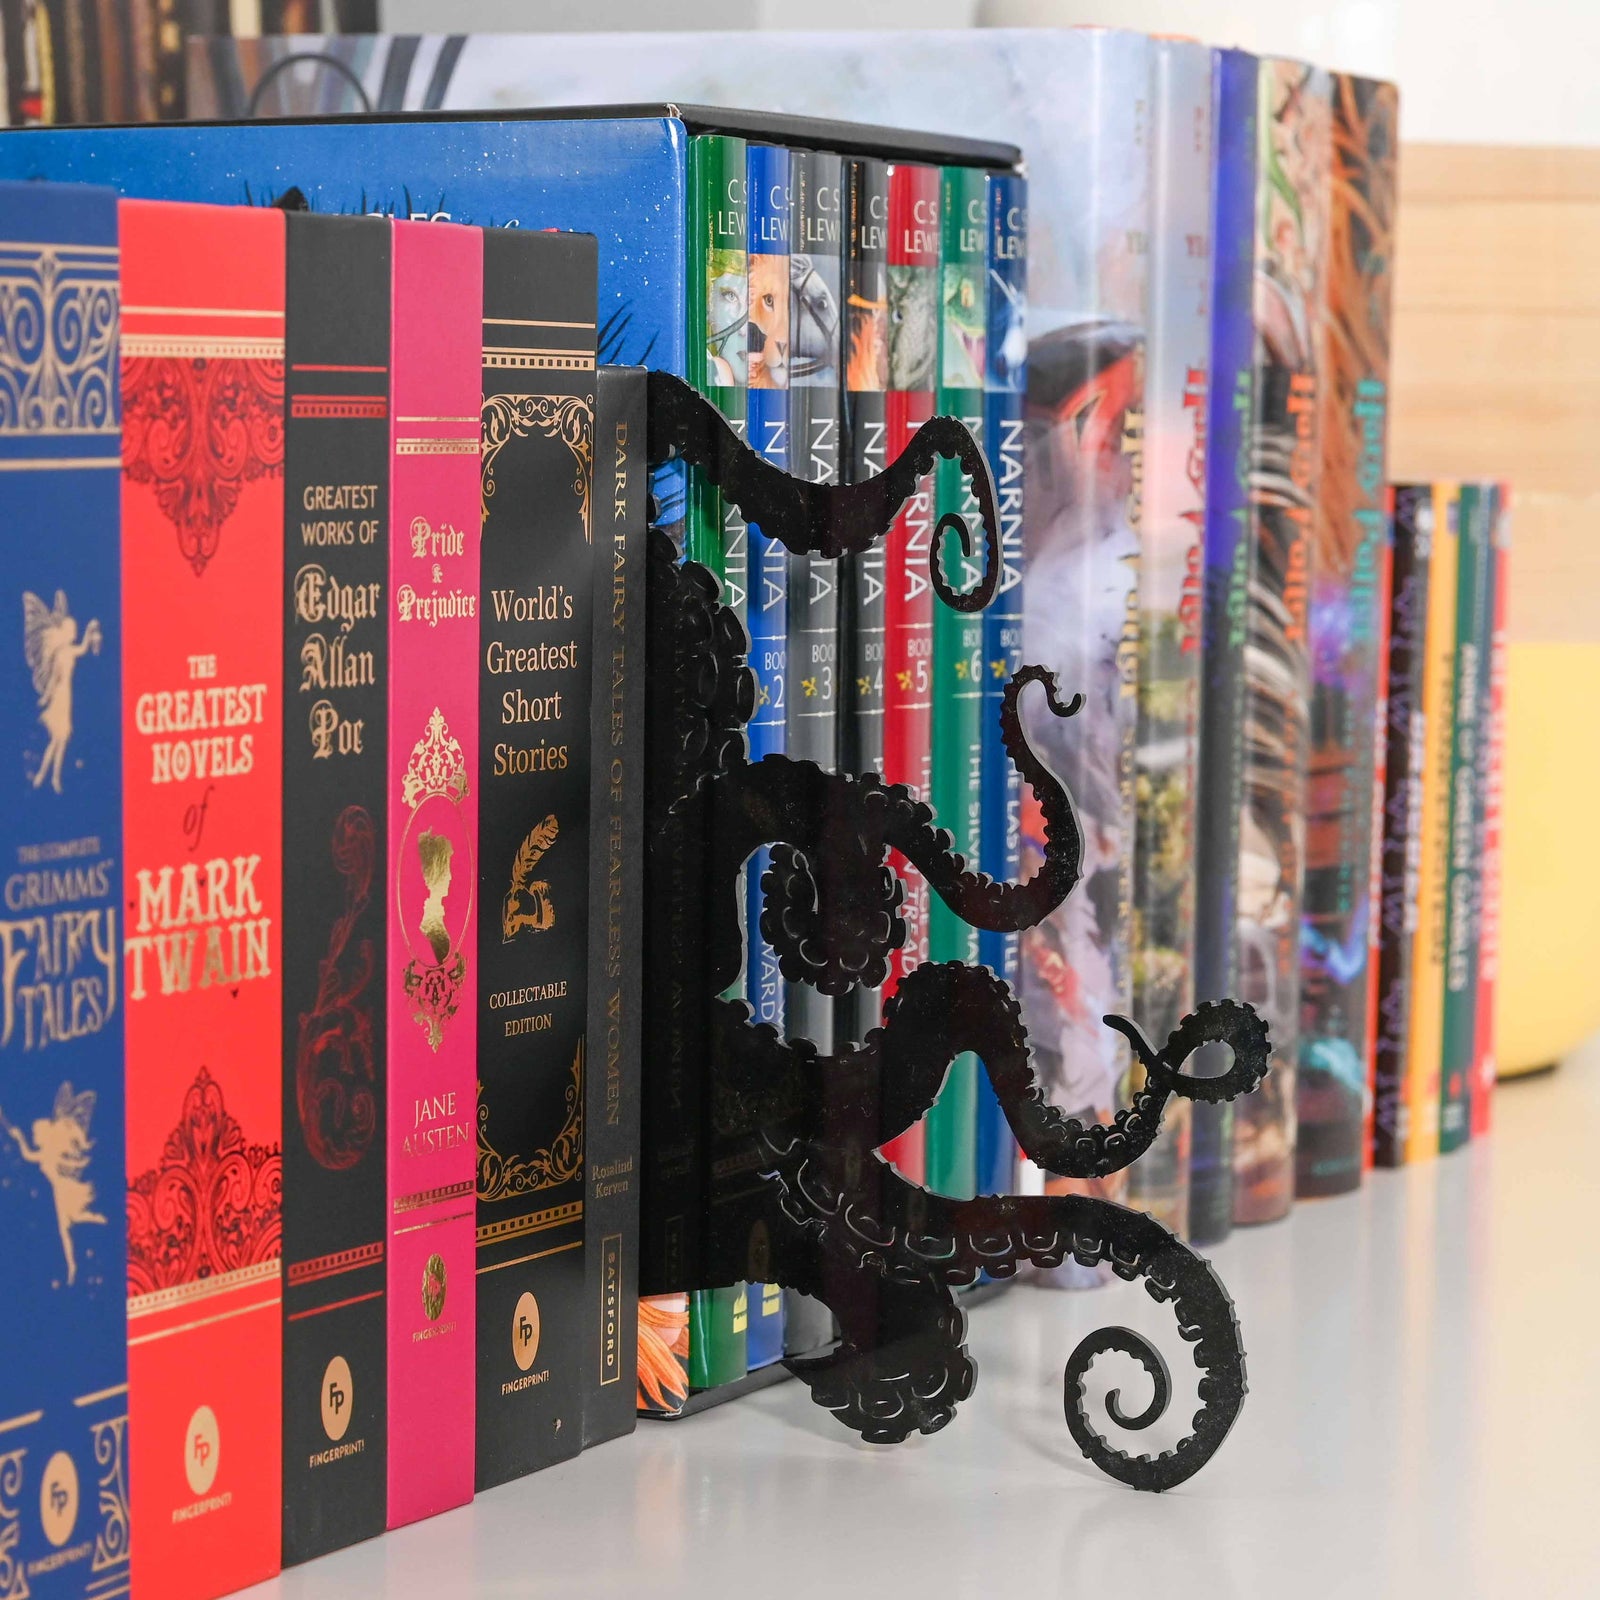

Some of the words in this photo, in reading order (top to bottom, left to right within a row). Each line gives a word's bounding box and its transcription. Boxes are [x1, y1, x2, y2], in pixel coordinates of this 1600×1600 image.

[613, 420, 629, 522] DARK
[303, 485, 378, 511] GREATEST
[1000, 420, 1024, 593] NARNIA
[301, 520, 354, 547] WORKS
[359, 520, 379, 545] OF
[409, 515, 466, 559] Pride
[293, 562, 381, 633] Edgar
[491, 585, 574, 622] World's
[612, 533, 628, 635] FAIRY
[396, 583, 477, 628] Prejudice
[187, 654, 217, 679] THE
[299, 632, 376, 693] Allan
[486, 640, 579, 675] Greatest
[916, 659, 928, 693] 5
[970, 648, 983, 683] 6
[610, 644, 626, 747] TALES
[773, 674, 785, 708] 2
[822, 665, 832, 700] 3
[873, 665, 884, 697] 4
[135, 683, 268, 735] GREATEST
[501, 688, 563, 725] Short
[308, 699, 366, 760] Poe
[151, 734, 254, 784] NOVELS
[493, 738, 569, 776] Stories
[608, 757, 624, 803] OF
[136, 853, 263, 933] MARK
[605, 813, 623, 979] FEARLESS
[0, 906, 117, 1047] FAIRY
[124, 916, 272, 1001] TWAIN
[18, 976, 104, 1053] TALES
[489, 980, 567, 1010] COLLECTABLE
[504, 1012, 553, 1037] EDITION
[604, 987, 622, 1126] WOMEN
[414, 1091, 457, 1129] JANE
[402, 1121, 470, 1158] AUSTEN
[591, 1154, 634, 1182] Rosalind
[606, 1251, 617, 1368] BATSFORD
[501, 1369, 550, 1396] FINGERPRINT!
[308, 1438, 365, 1469] FINGERPRINT!
